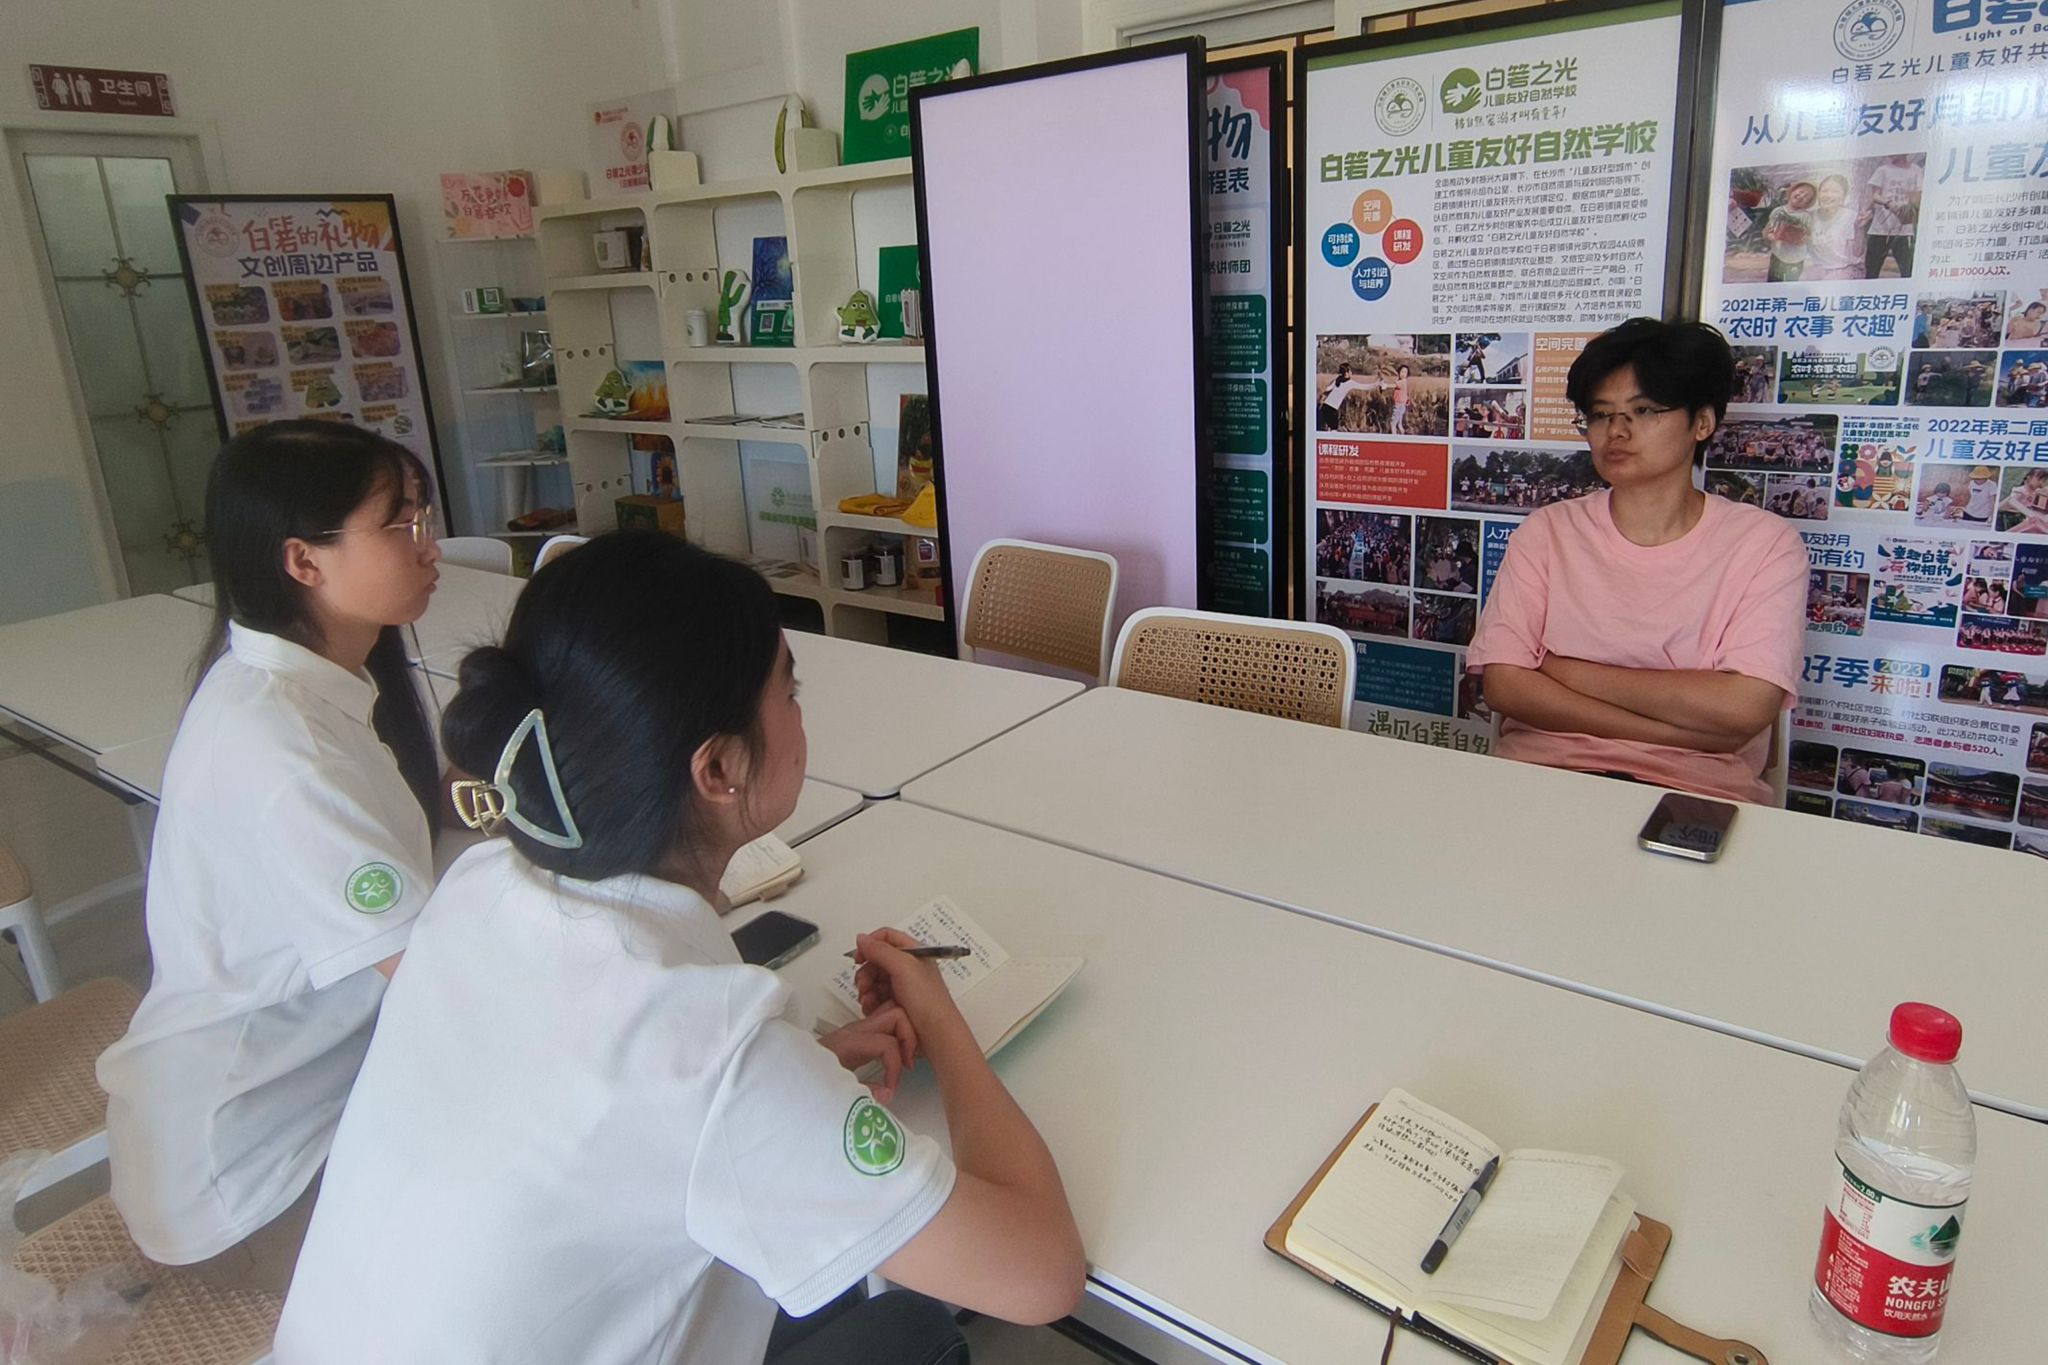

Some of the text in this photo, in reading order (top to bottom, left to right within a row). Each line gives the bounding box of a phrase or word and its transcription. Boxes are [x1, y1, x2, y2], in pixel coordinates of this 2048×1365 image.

[2010, 25, 2025, 36] of
[98, 78, 152, 97] 卫生间
[1483, 85, 1577, 108] 儿童友好自然学校
[238, 251, 379, 278] 文创周边产品
[1355, 267, 1388, 278] 人才引进
[1722, 294, 1908, 313] 2021年第一届儿童友好月
[1783, 314, 1834, 339] 农事
[1928, 418, 2048, 437] 2022年第二届
[1318, 443, 1360, 457] 课程研发
[1880, 659, 1923, 676] 2023
[1885, 1296, 1935, 1311] NONGFU
